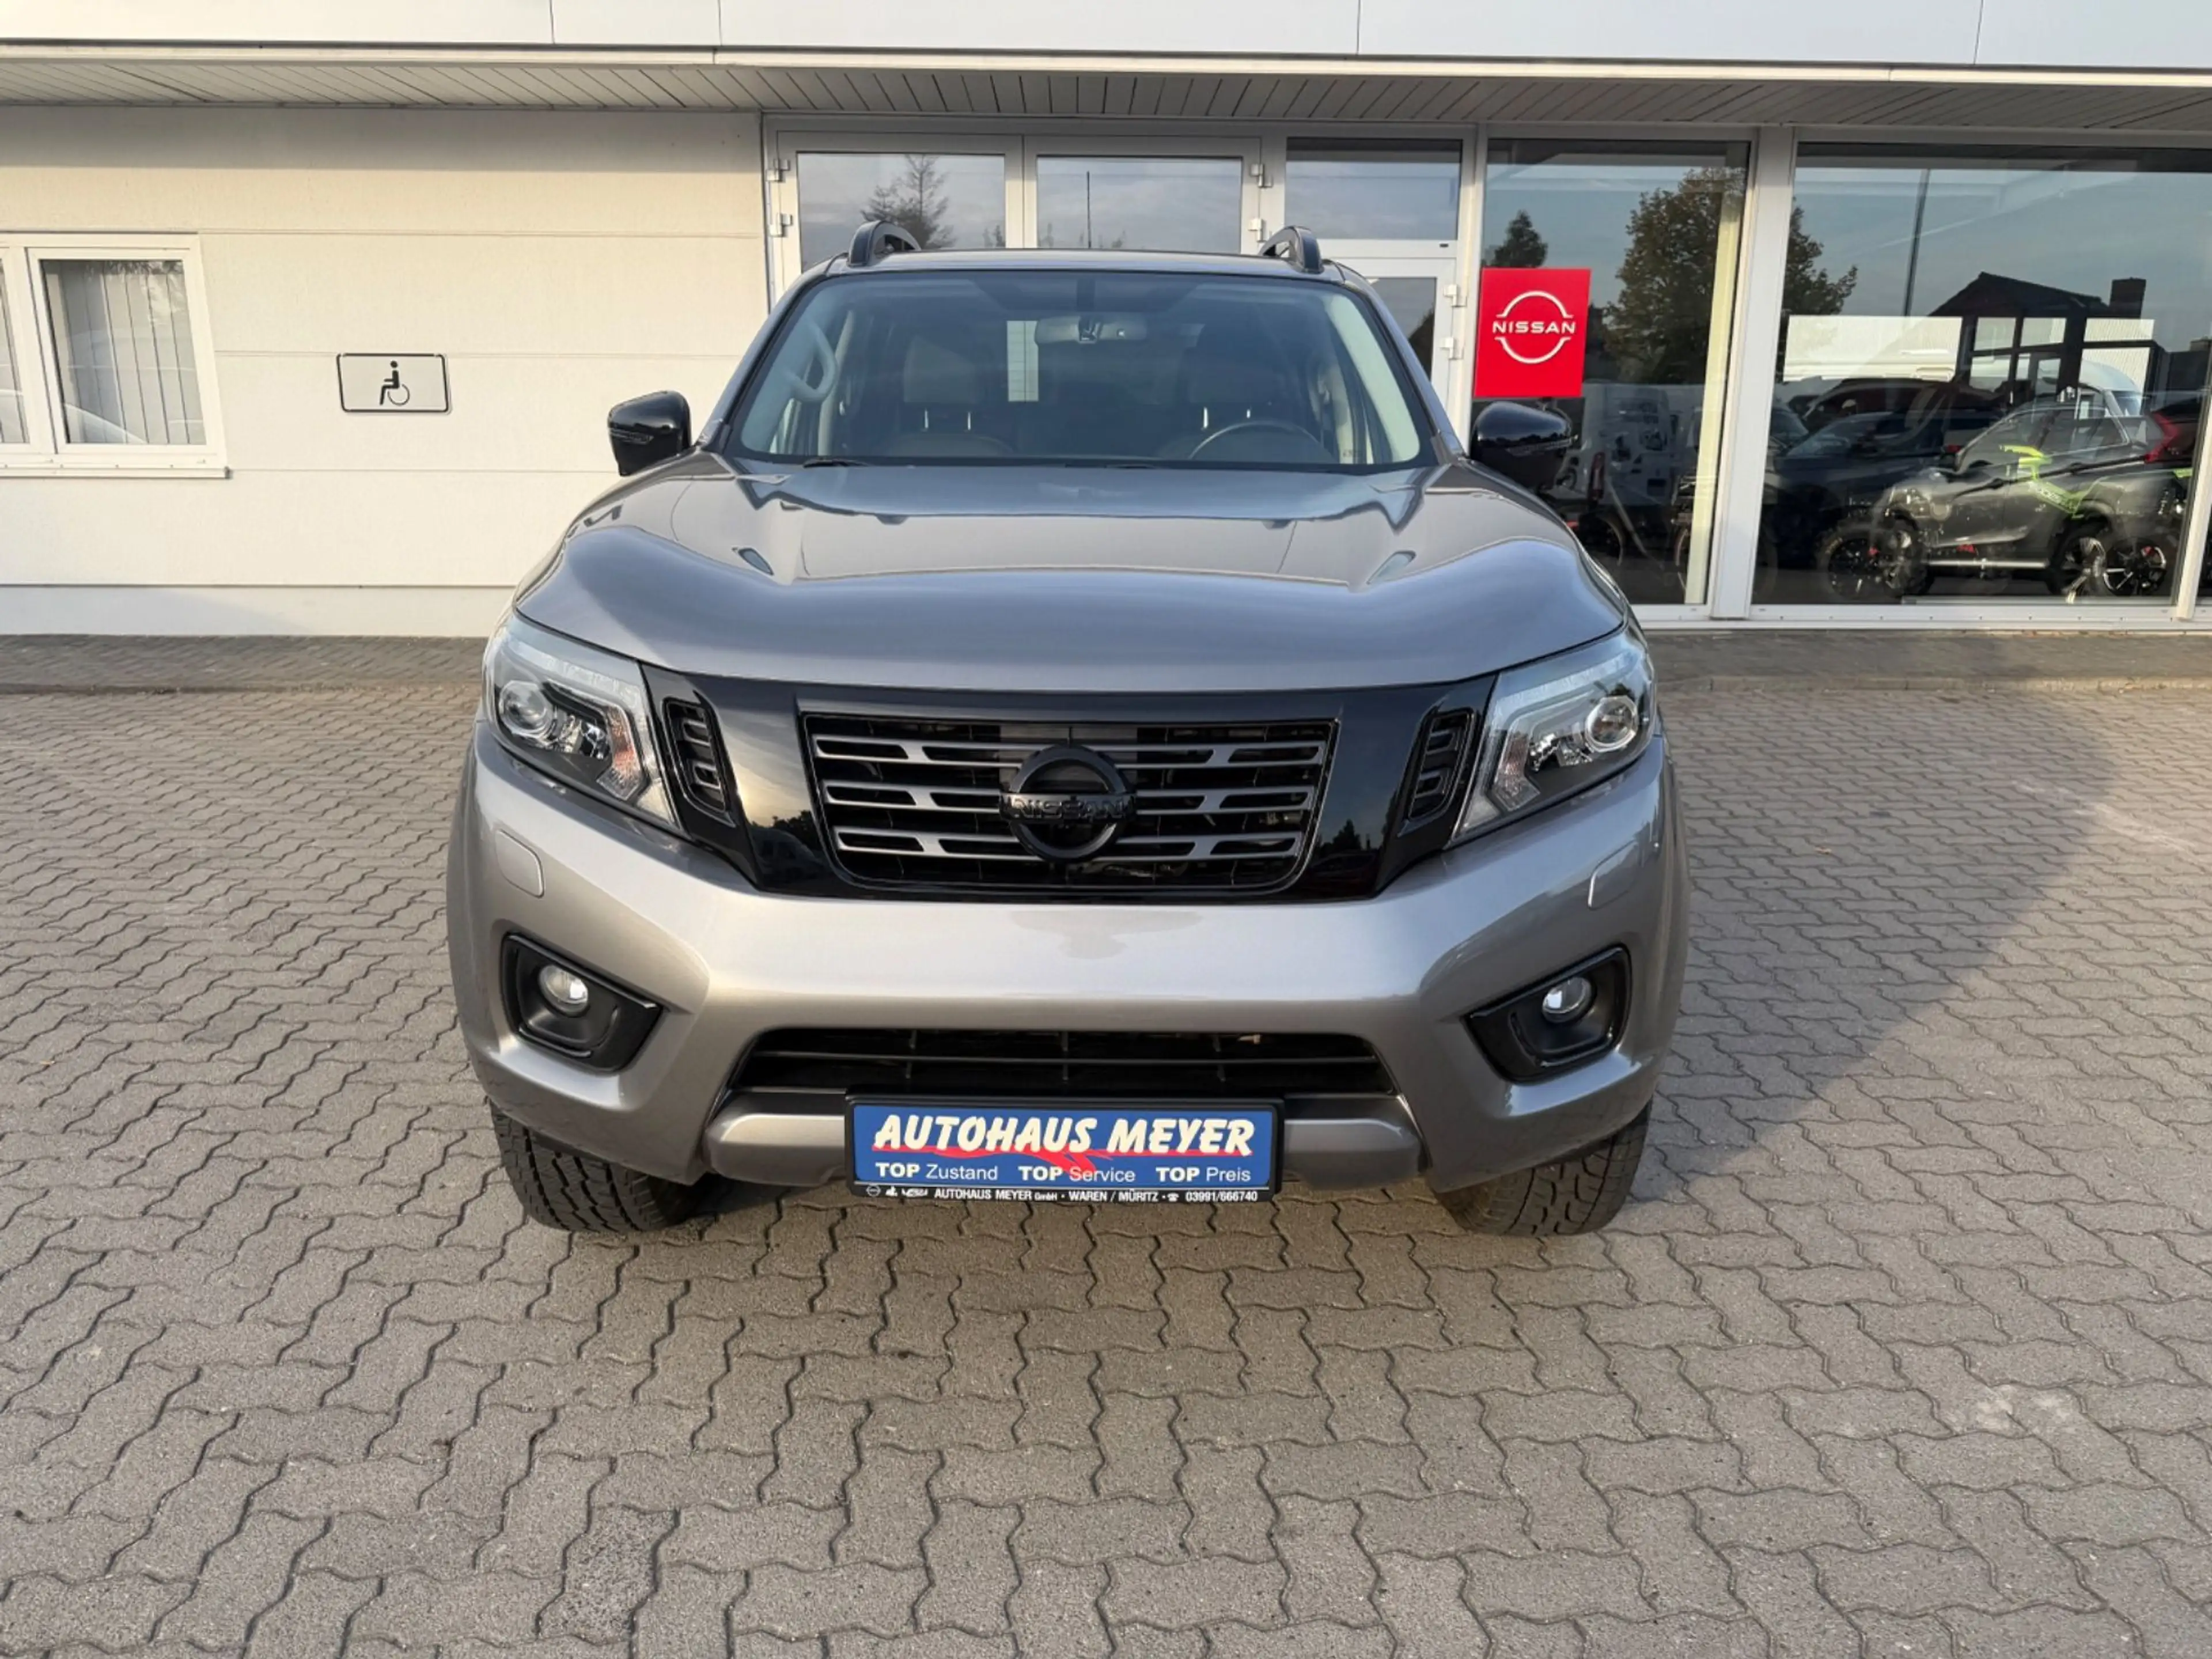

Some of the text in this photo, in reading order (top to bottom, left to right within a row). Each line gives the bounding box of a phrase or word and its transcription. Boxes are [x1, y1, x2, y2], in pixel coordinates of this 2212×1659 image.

[1492, 320, 1576, 334] NISSAN
[874, 1115, 1255, 1156] AUTOHAUS MEYER
[875, 1162, 1251, 1182] TOP Zustand TOP Service TOP Preis
[934, 1188, 992, 1199] AUTOHAUS
[995, 1190, 1032, 1200] MEYER
[1035, 1192, 1058, 1200] GmbH
[1069, 1191, 1107, 1202] WAREN
[1119, 1188, 1158, 1202] MÜRITZ
